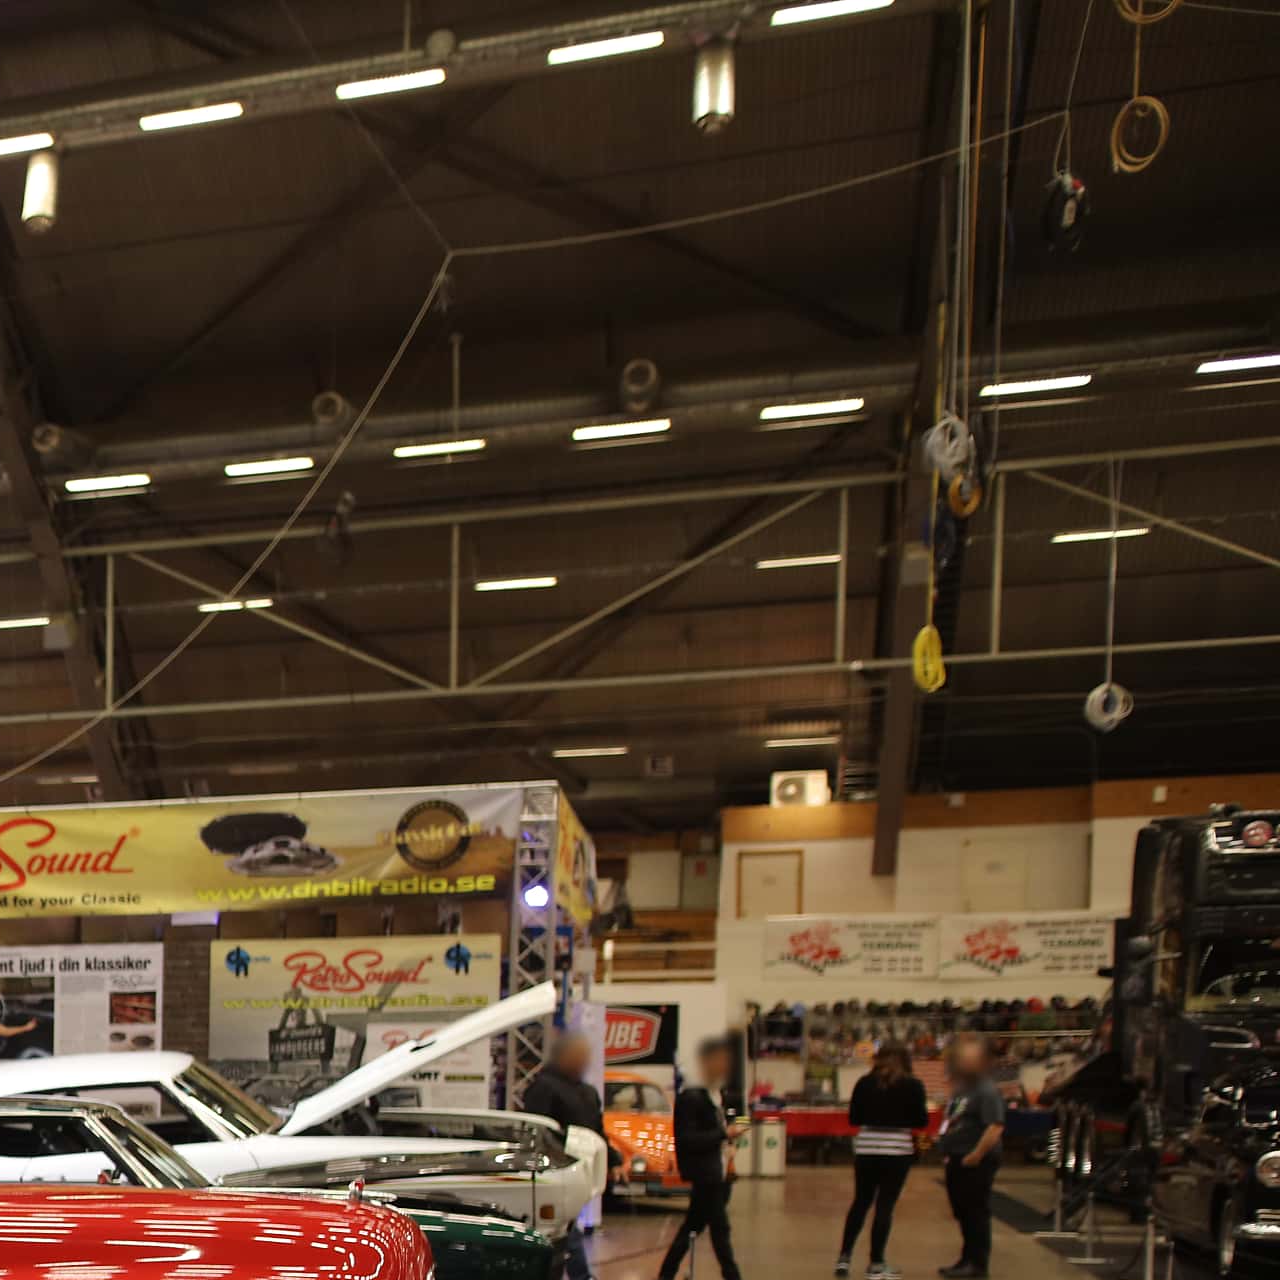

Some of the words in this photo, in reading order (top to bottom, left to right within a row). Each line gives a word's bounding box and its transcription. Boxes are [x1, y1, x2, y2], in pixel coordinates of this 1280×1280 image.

[13, 895, 34, 908] for
[39, 896, 75, 909] your
[81, 894, 141, 906] Classic
[20, 958, 45, 976] ljud
[59, 958, 80, 972] din
[85, 955, 152, 971] klassiker
[604, 1021, 645, 1048] UBE
